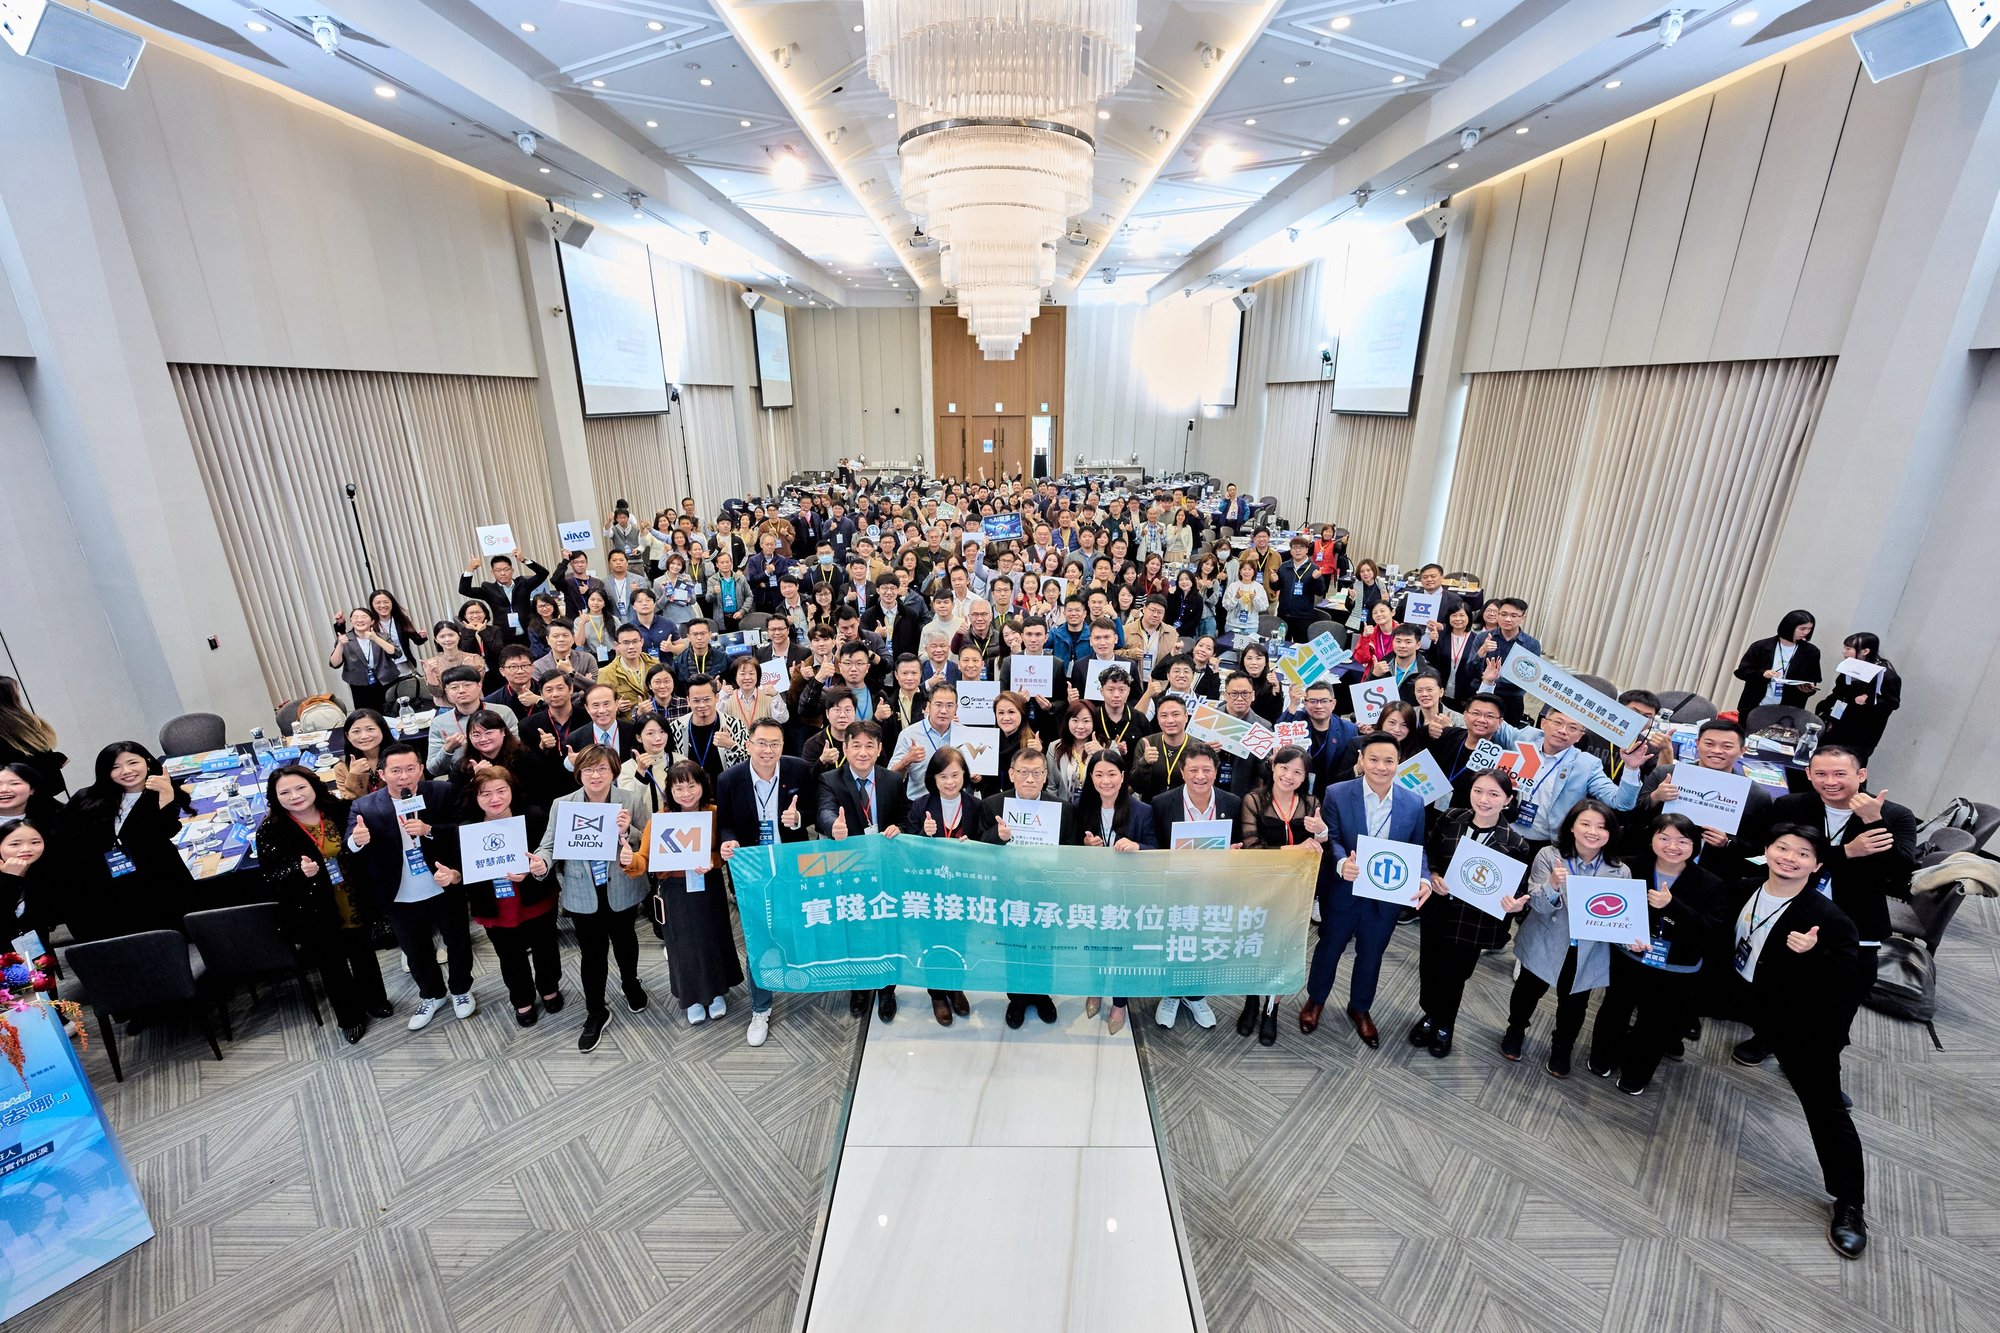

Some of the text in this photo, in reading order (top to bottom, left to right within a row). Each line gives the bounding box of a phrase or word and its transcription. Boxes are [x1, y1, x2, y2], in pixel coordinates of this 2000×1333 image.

[1538, 682, 1626, 737] YOU SHOULD BE HERE
[1478, 740, 1500, 757] i2C
[1718, 795, 1738, 806] Lian
[567, 840, 604, 849] UNION
[575, 833, 600, 841] BAY
[475, 853, 516, 869] 智慧高軟
[801, 889, 1269, 933] 實踐企業接班傳承與數位轉型的
[1585, 918, 1632, 929] HELATEC
[1132, 934, 1264, 963] 一把交椅
